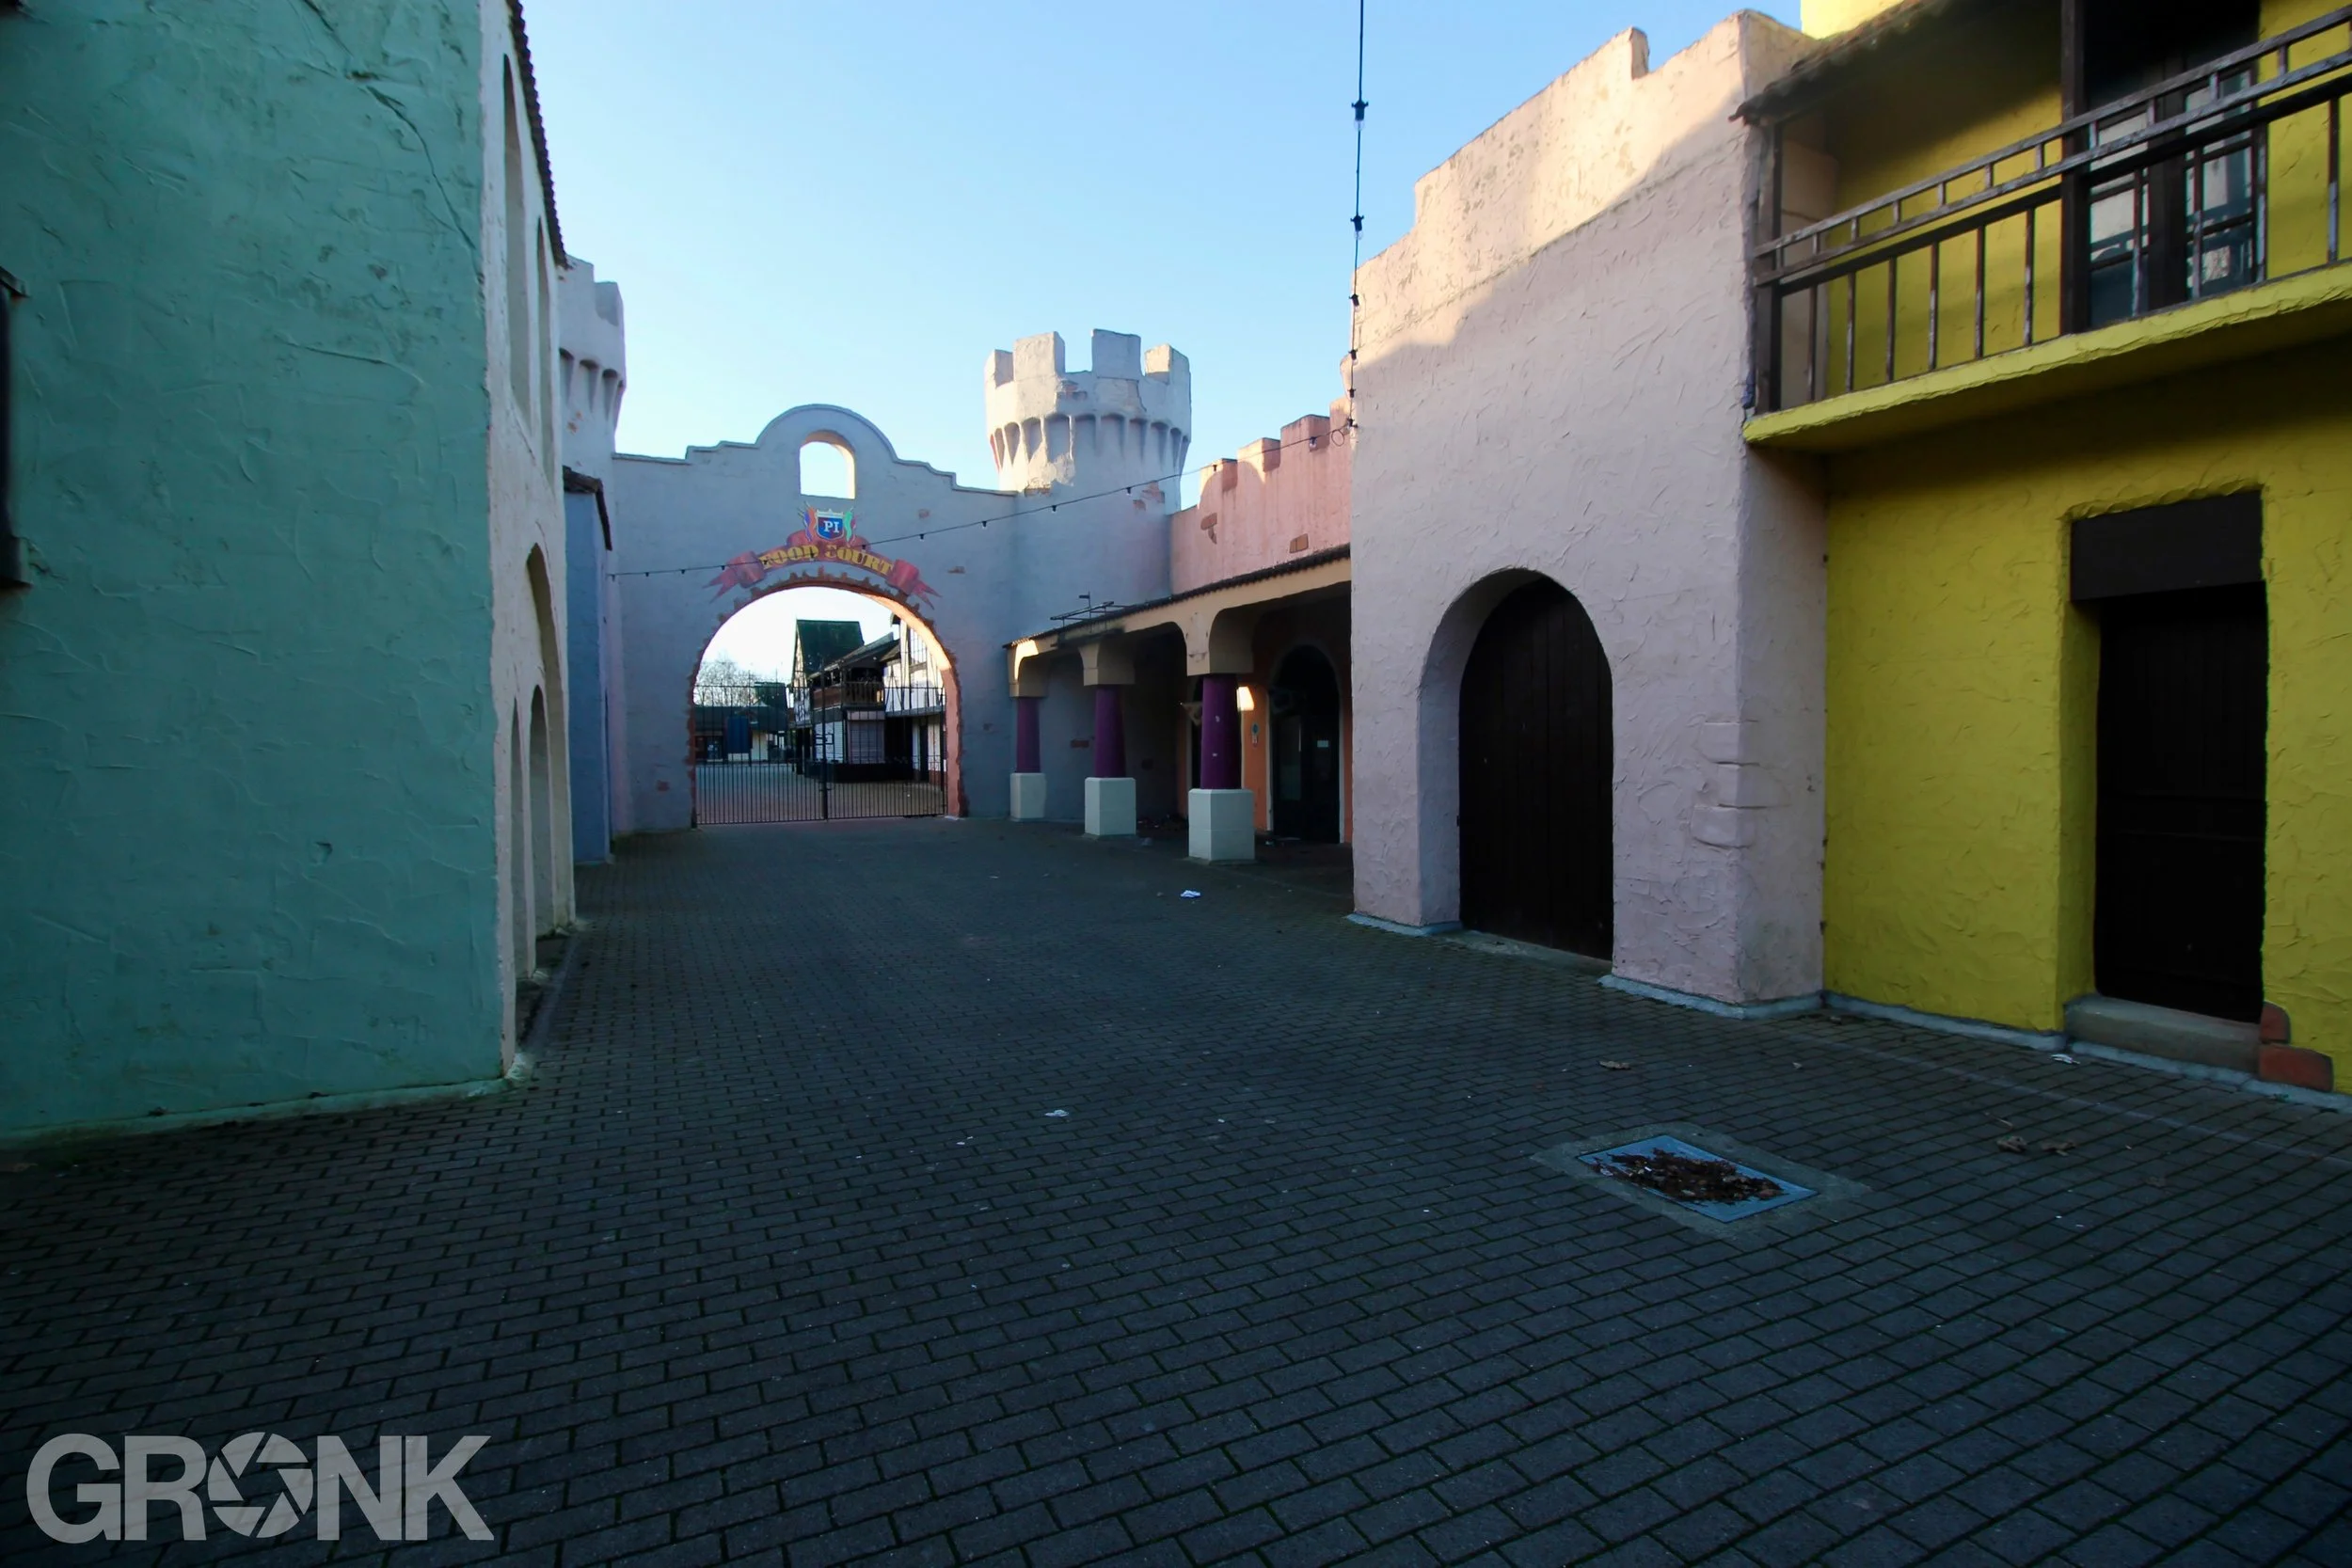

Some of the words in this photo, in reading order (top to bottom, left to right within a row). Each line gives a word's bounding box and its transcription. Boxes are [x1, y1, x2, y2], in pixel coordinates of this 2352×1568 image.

[822, 520, 840, 533] PI
[758, 545, 819, 570] FOOD
[825, 545, 894, 575] COURT
